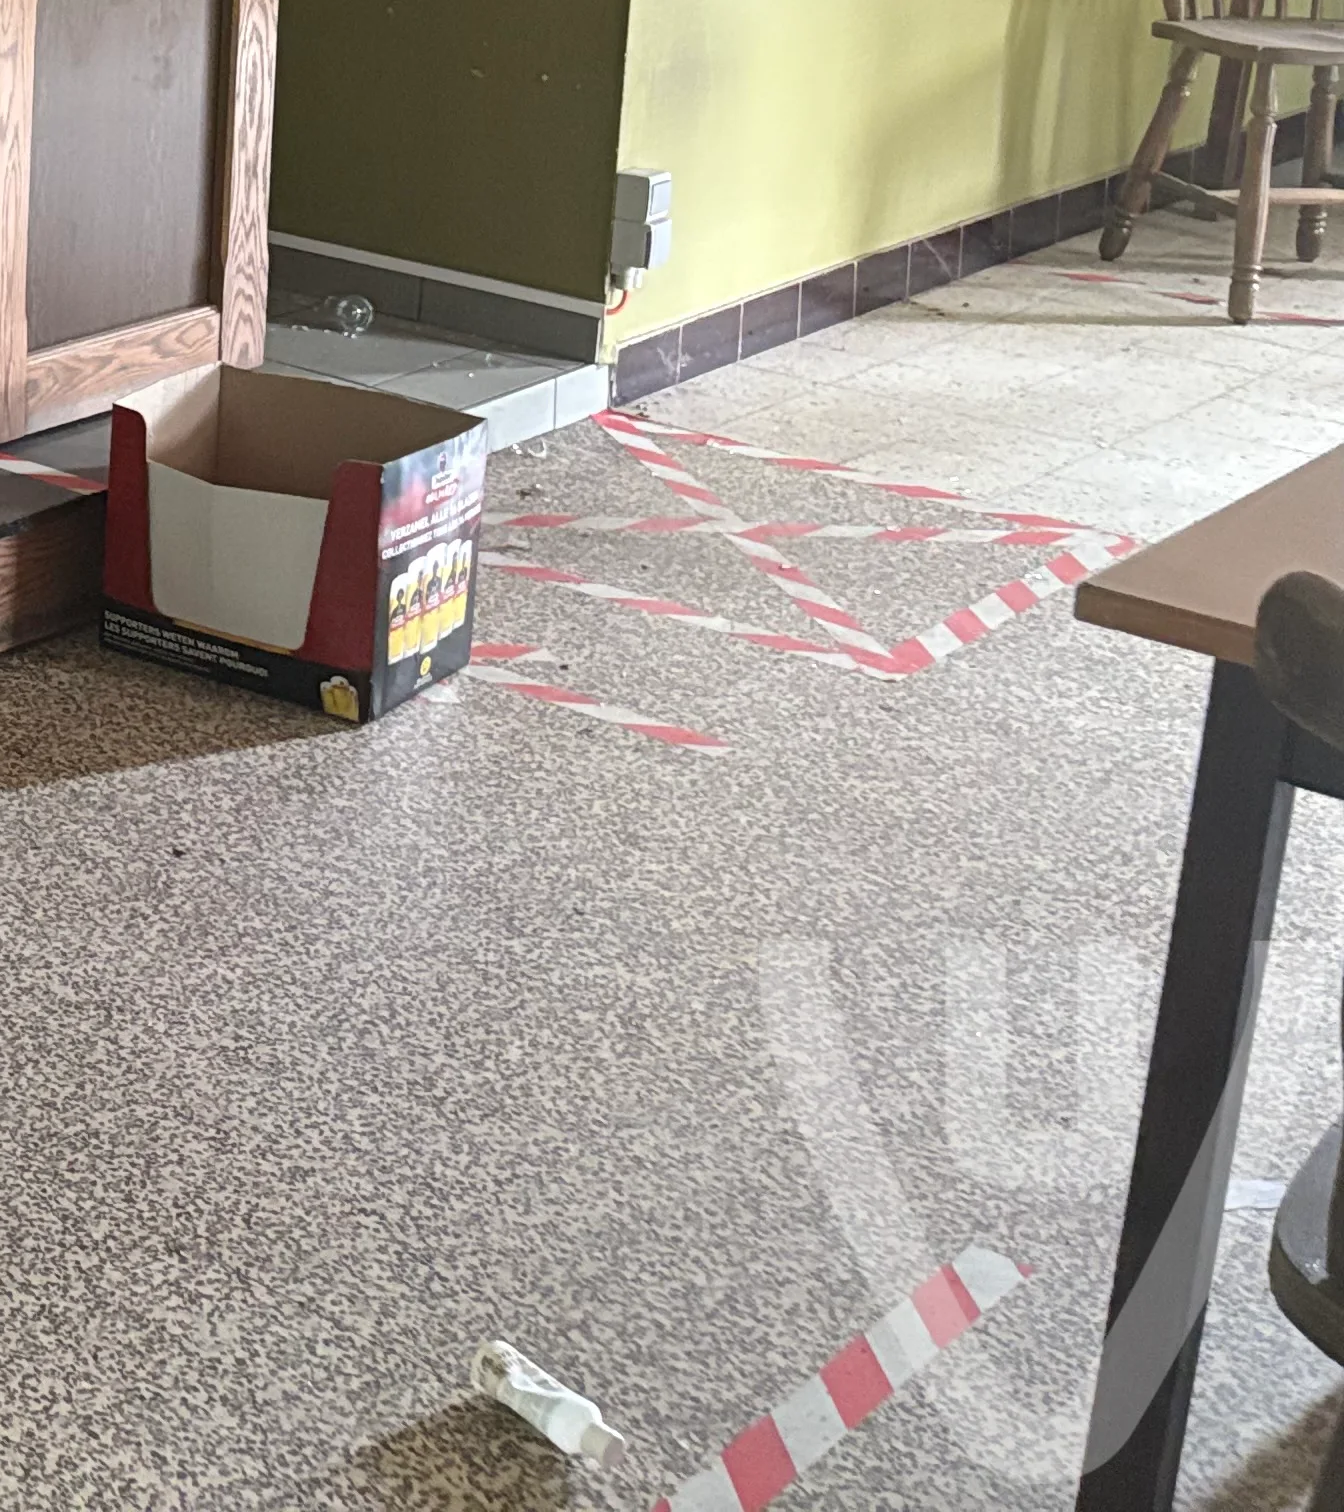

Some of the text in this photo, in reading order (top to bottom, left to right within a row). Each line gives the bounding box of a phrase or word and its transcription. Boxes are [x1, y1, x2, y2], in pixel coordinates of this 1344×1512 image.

[103, 610, 161, 638] SUPPORTERS
[161, 629, 196, 647] WETEN
[197, 639, 240, 659] WAAROM
[103, 620, 121, 635] LES
[121, 626, 181, 653] SUPPORTERS
[181, 645, 218, 664] SAVENT
[218, 656, 270, 679] POURQUOI
